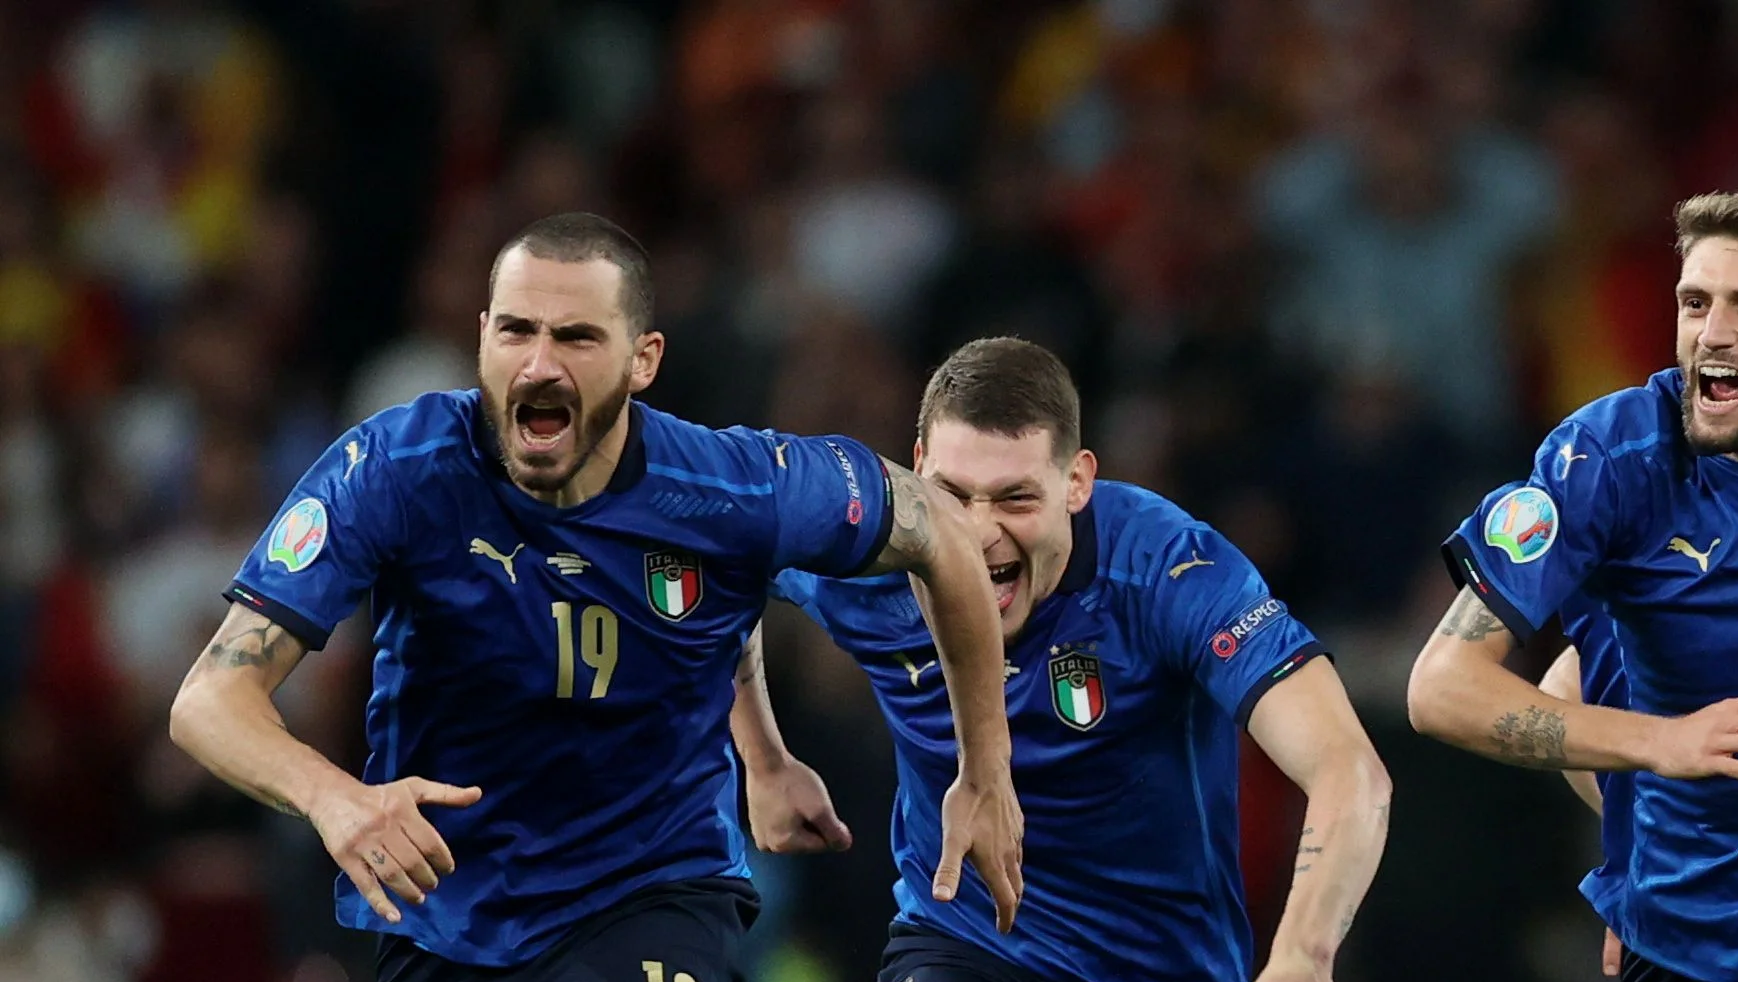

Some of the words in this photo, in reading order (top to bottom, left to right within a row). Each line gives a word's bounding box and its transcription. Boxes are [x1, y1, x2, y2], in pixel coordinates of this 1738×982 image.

[1231, 599, 1281, 640] RESPECT
[551, 601, 619, 699] 19
[1054, 658, 1098, 675] ITALIA
